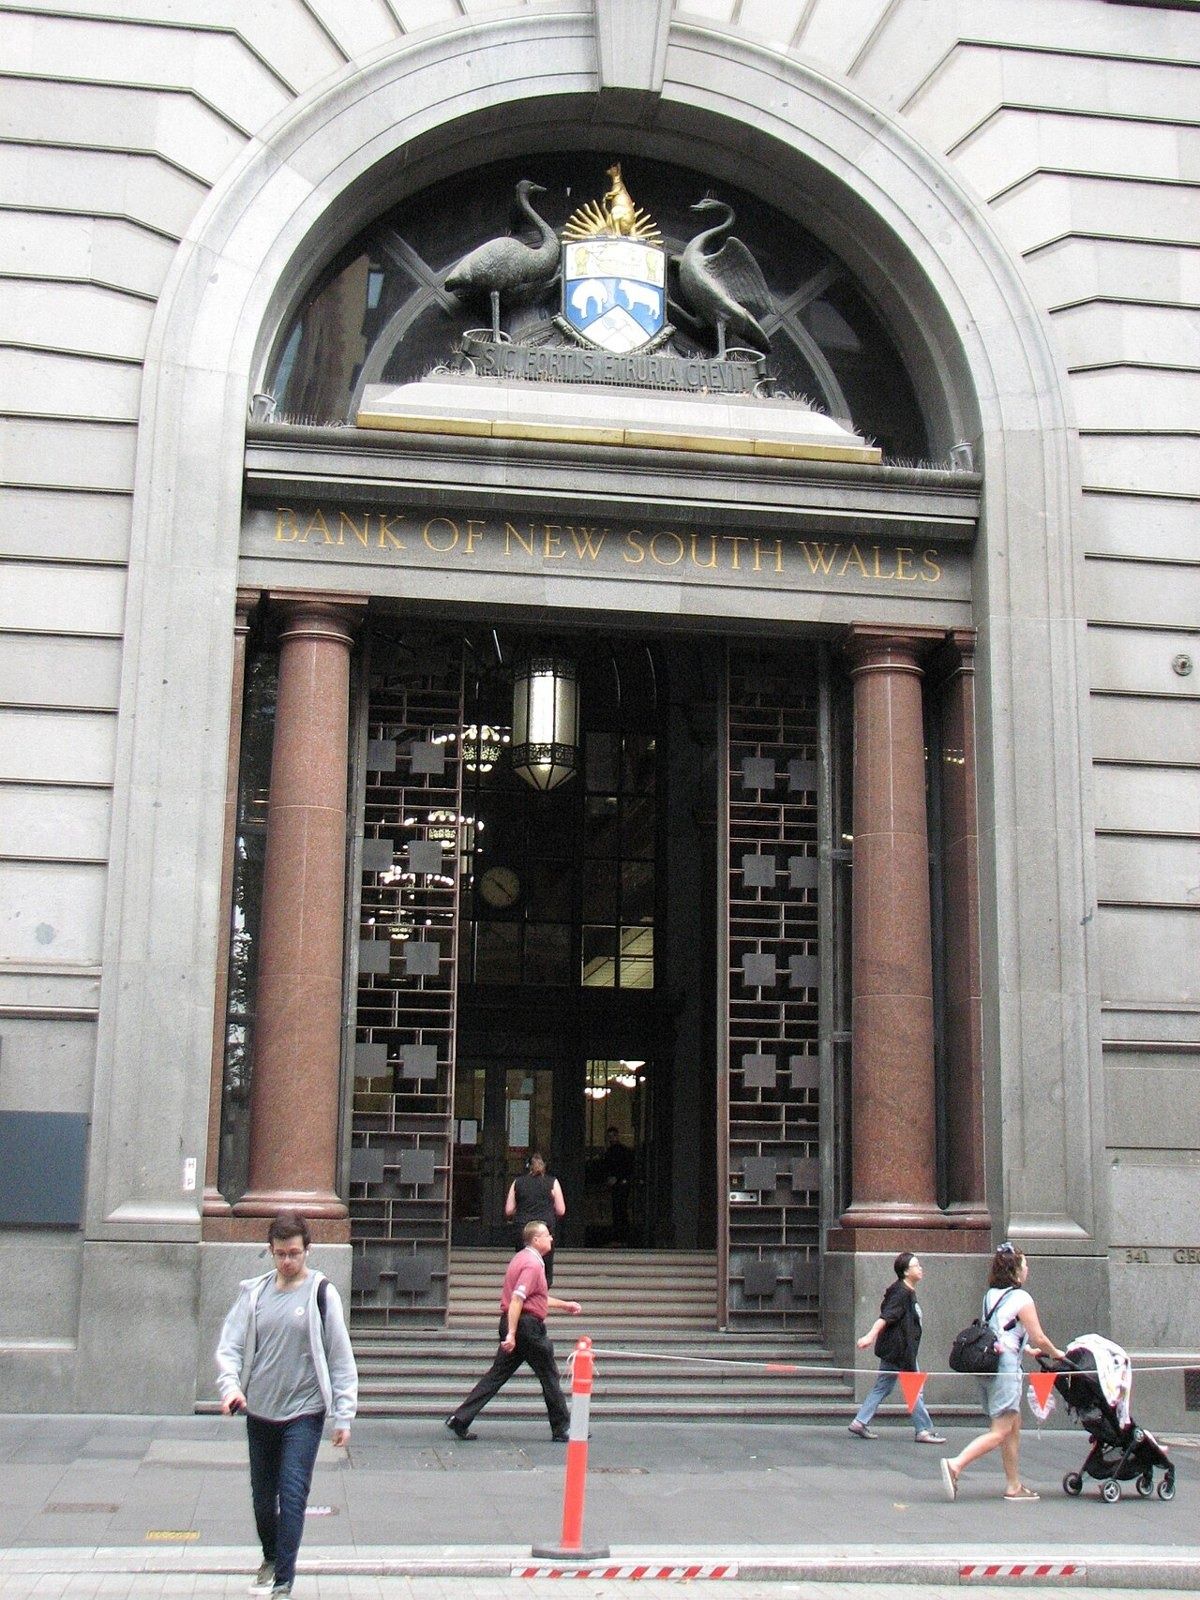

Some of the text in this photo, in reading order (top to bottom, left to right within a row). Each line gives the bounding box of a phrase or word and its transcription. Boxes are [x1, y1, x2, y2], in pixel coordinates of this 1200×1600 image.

[526, 352, 595, 379] FORTIS
[602, 356, 679, 385] ETRURIA
[274, 507, 944, 582] BANK OF NEW SOUTH WALES
[1125, 1249, 1200, 1264] 341 GE
